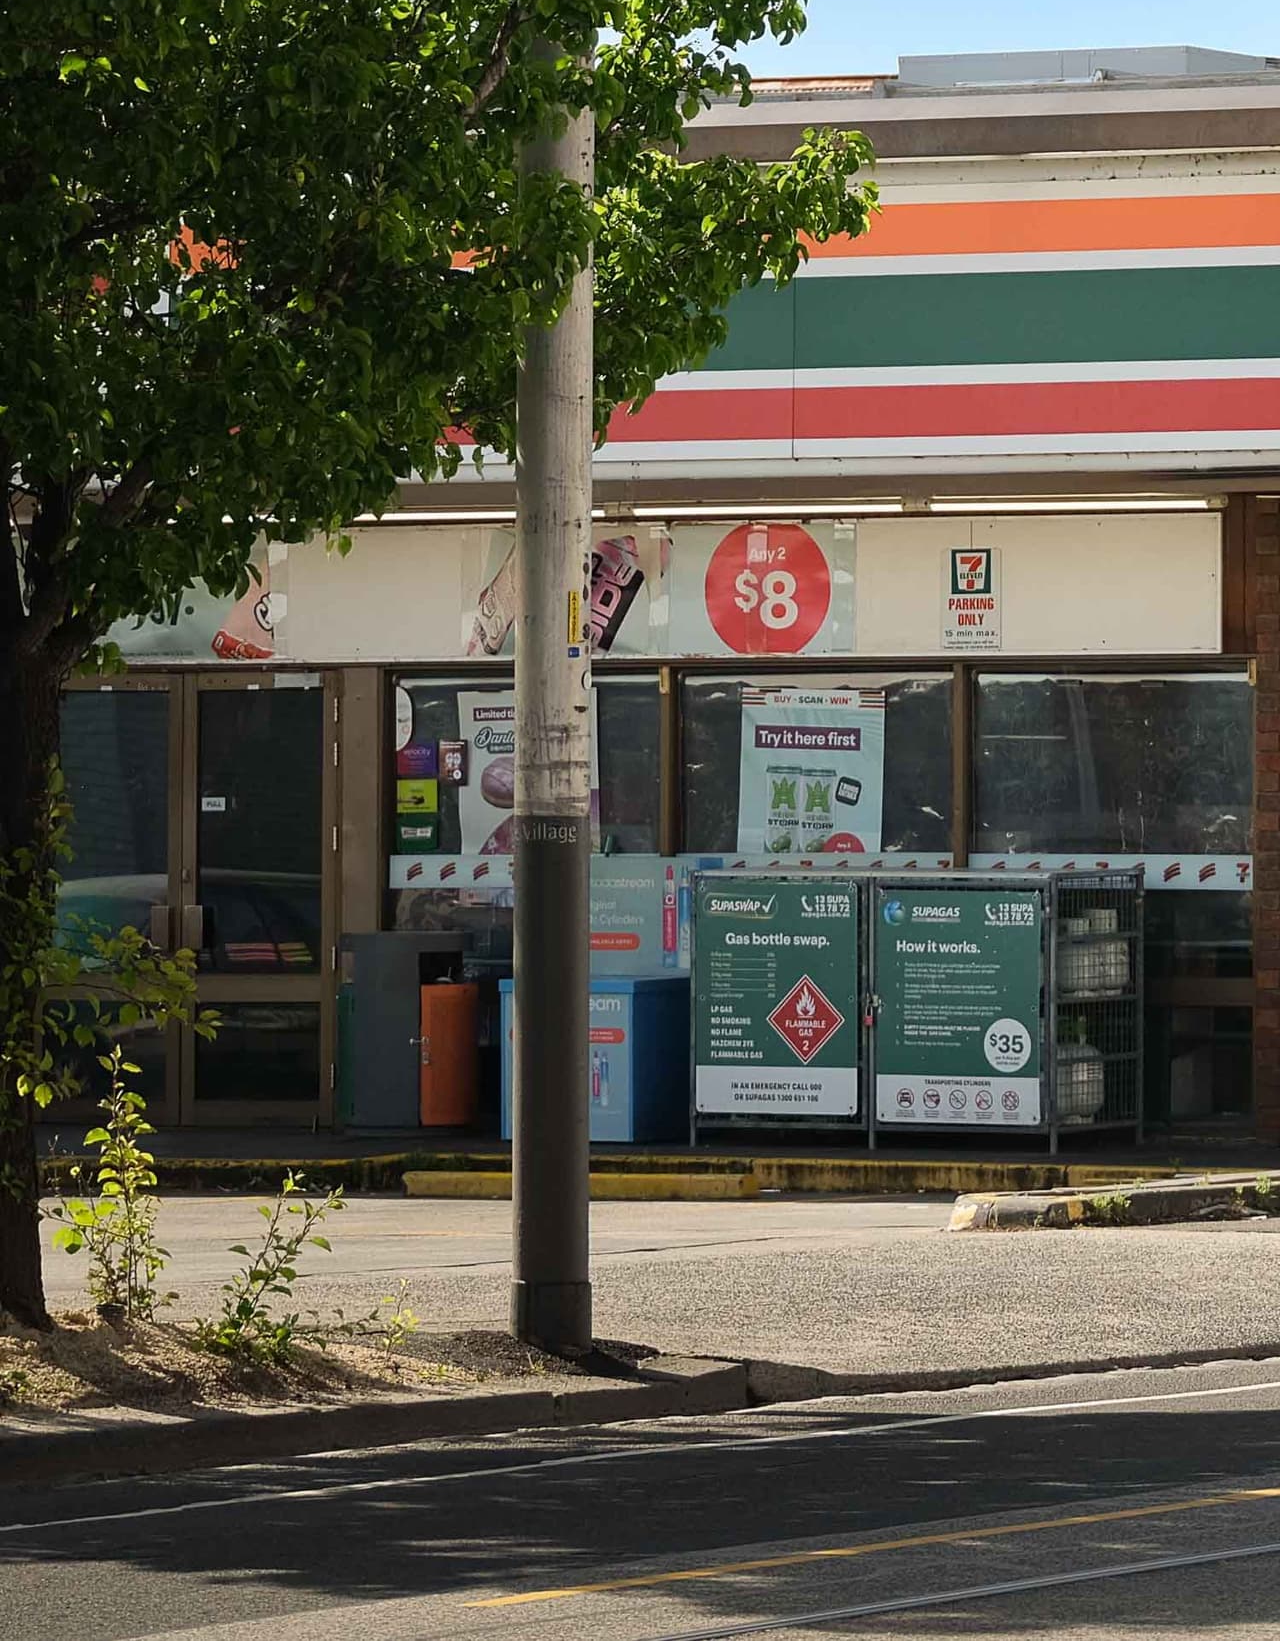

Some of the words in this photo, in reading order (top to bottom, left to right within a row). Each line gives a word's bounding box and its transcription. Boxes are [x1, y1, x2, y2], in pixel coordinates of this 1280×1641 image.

[748, 549, 776, 564] Any
[777, 547, 786, 560] 2
[734, 569, 799, 630] $8
[948, 598, 995, 611] PARKING
[958, 613, 985, 626] ONLY
[773, 695, 791, 704] BUY
[798, 695, 823, 705] SCAN
[476, 709, 506, 719] Limited
[759, 730, 781, 747] Try
[782, 731, 793, 744] it
[795, 731, 825, 745] here
[828, 732, 856, 747] first
[815, 895, 825, 904] 13
[710, 898, 761, 913] SUPASWAP
[815, 904, 826, 912] 13
[839, 904, 850, 913] 72
[998, 903, 1009, 912] 13
[911, 906, 961, 917] SUPAGAS
[998, 912, 1009, 921] 13
[1023, 912, 1034, 921] 72
[725, 933, 750, 945] Gas
[752, 932, 791, 945] bottle
[793, 936, 830, 949] swap.
[896, 940, 926, 952] How
[927, 940, 936, 952] it
[939, 940, 981, 954] works.
[785, 1019, 826, 1029] FLAMMABLE
[798, 1028, 814, 1037] GAS
[802, 1041, 809, 1051] 2
[989, 1033, 1024, 1054] $35
